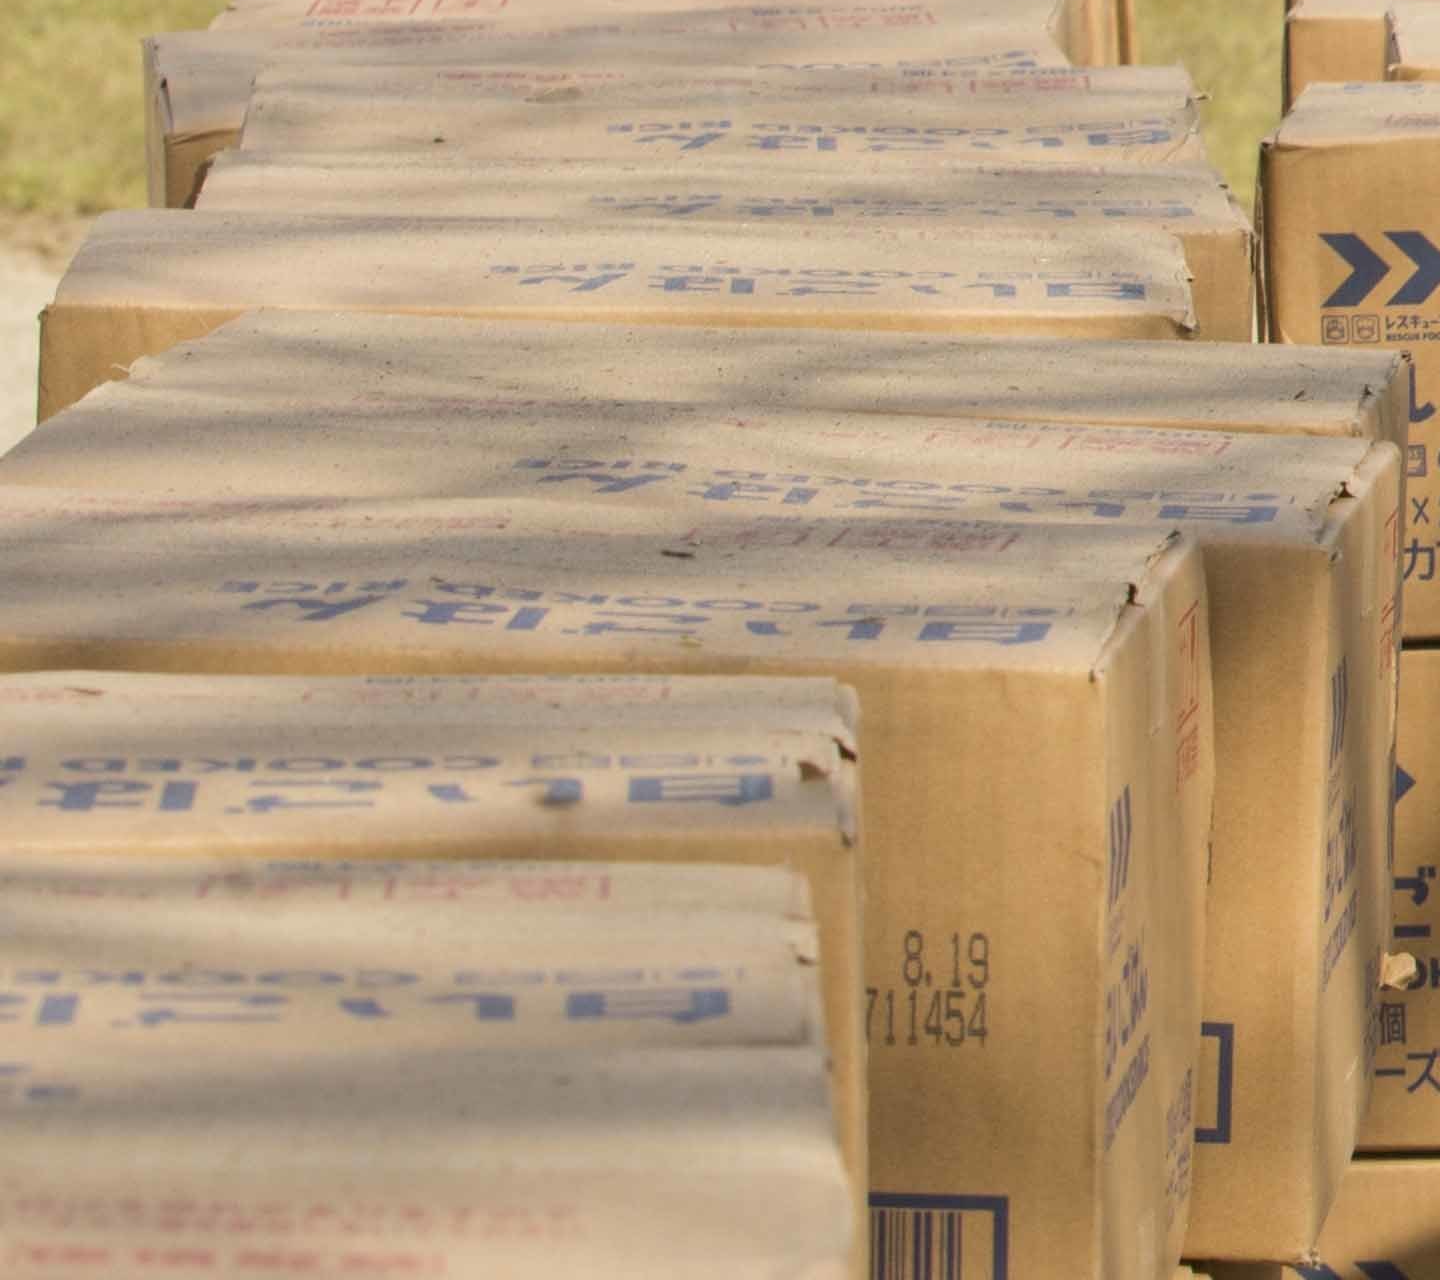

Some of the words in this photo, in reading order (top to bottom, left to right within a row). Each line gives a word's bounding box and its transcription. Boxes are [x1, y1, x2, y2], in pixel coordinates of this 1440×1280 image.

[536, 473, 1280, 524] 白いごはん
[239, 594, 1053, 645] 白いごはん
[0, 774, 774, 814] 白いごは
[0, 990, 732, 1029] 白いご
